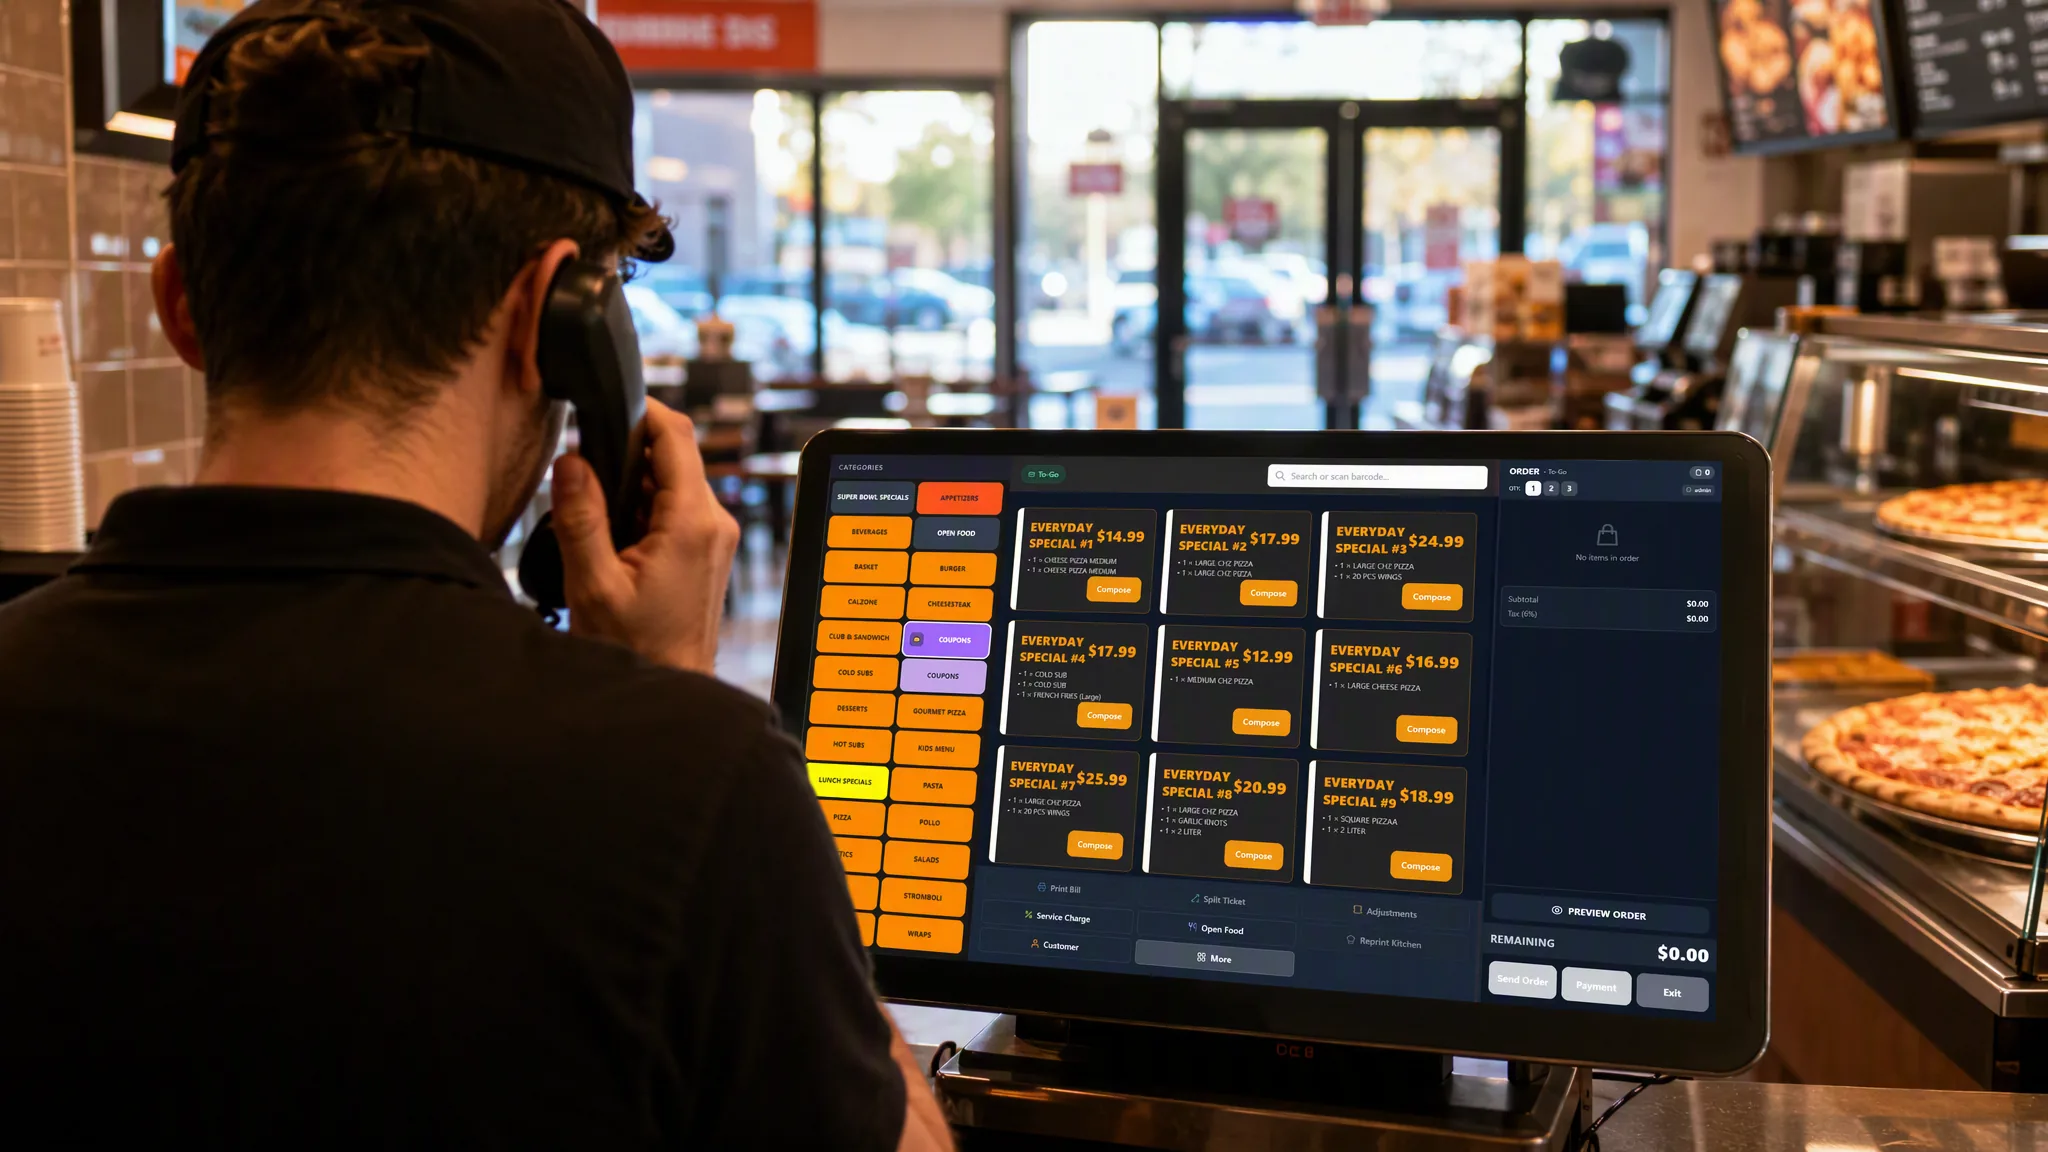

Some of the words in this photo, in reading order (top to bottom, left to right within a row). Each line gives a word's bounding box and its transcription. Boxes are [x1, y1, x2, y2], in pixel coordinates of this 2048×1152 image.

[1038, 470, 1060, 479] To-Go
[1291, 472, 1317, 481] Search
[1320, 473, 1329, 481] or
[1330, 473, 1349, 481] scan
[1509, 468, 1540, 476] ORDER
[837, 493, 858, 501] SUPER
[859, 493, 878, 501] BOWL
[851, 528, 888, 536] BEVERAGES
[1030, 522, 1094, 533] EVERYDAY
[1180, 524, 1246, 535] EVERYDAY
[1336, 526, 1406, 537] EVERYDAY
[1097, 529, 1145, 543] $14.99
[1250, 531, 1300, 546] $17.99
[1408, 533, 1464, 549] $24.99
[1029, 538, 1077, 549] SPECIAL
[1079, 539, 1093, 549] #1
[1178, 541, 1229, 551] SPECIAL
[1232, 542, 1247, 552] #2
[1335, 544, 1388, 554] SPECIAL
[1391, 544, 1407, 554] #3
[1588, 554, 1609, 562] items
[1096, 585, 1132, 594] Compose
[1250, 589, 1287, 598] Compose
[847, 598, 878, 606] CALZONE
[1413, 593, 1451, 602] Compose
[1508, 596, 1539, 604] Subtotal
[927, 600, 971, 608] CHEESESTEAK
[1686, 600, 1709, 608] $0.00
[1507, 610, 1520, 618] Tax
[1521, 610, 1538, 619] (6%)
[1686, 614, 1709, 623] $0.00
[939, 636, 972, 644] COUPONS
[1021, 635, 1084, 647] EVERYDAY
[1088, 643, 1137, 658] $17.99
[1172, 640, 1239, 652] EVERYDAY
[1330, 645, 1401, 657] EVERYDAY
[1019, 652, 1068, 663] SPECIAL
[1071, 654, 1086, 664] #4
[1242, 648, 1293, 664] $12.99
[1170, 657, 1221, 668] SPECIAL
[1224, 659, 1240, 669] #5
[1405, 654, 1460, 669] $16.99
[856, 669, 874, 677] SUBS
[1329, 662, 1383, 674] SPECIAL
[1386, 664, 1403, 675] #6
[927, 672, 959, 680] COUPONS
[1372, 683, 1398, 691] CHEESE
[1400, 684, 1421, 692] PIZZA
[837, 705, 868, 713] DESSERTS
[913, 708, 946, 716] GOURMET
[1087, 711, 1122, 721] Compose
[1242, 718, 1280, 728] Compose
[1407, 725, 1446, 735] Compose
[848, 741, 865, 749] SUBS
[918, 744, 933, 752] KIDS
[934, 745, 955, 753] MENU
[1010, 761, 1074, 774] EVERYDAY
[1076, 770, 1128, 786] $25.99
[1163, 769, 1231, 782] EVERYDAY
[818, 777, 842, 785] LUNCH
[842, 778, 872, 786] SPECIALS
[923, 782, 944, 790] PASTA
[1009, 778, 1057, 790] SPECIAL
[1060, 781, 1076, 791] #7
[1324, 777, 1395, 791] EVERYDAY
[1233, 779, 1287, 795] $20.99
[1162, 786, 1213, 799] SPECIAL
[1216, 789, 1233, 800] #8
[1400, 787, 1454, 804] $18.99
[1323, 795, 1377, 808] SPECIAL
[1380, 798, 1397, 809] #9
[1340, 815, 1370, 824] SQUARE
[1077, 840, 1113, 851] Compose
[913, 856, 940, 864] SALADS
[1235, 850, 1273, 861] Compose
[1401, 861, 1441, 872] Compose
[1050, 885, 1068, 893] Print
[1069, 886, 1081, 894] Bill
[904, 892, 942, 901] STROMBOLI
[1223, 897, 1246, 906] Ticket
[1036, 912, 1063, 921] Service
[1064, 914, 1091, 924] Charge
[1366, 907, 1418, 919] Adjustments
[1568, 907, 1610, 918] PREVIEW
[1613, 911, 1647, 921] ORDER
[907, 930, 932, 939] WRAPS
[1201, 925, 1223, 934] Open
[1224, 926, 1244, 935] Food
[1043, 941, 1079, 951] Customer
[1360, 937, 1390, 947] Reprint
[1391, 939, 1422, 949] Kitchen
[1490, 934, 1555, 948] REMAINING
[1657, 944, 1709, 963] $0.00
[1210, 955, 1232, 964] More
[1497, 974, 1520, 984] Send
[1522, 976, 1549, 987] Order
[1576, 981, 1617, 994] Payment
[1663, 988, 1682, 998] Exit
